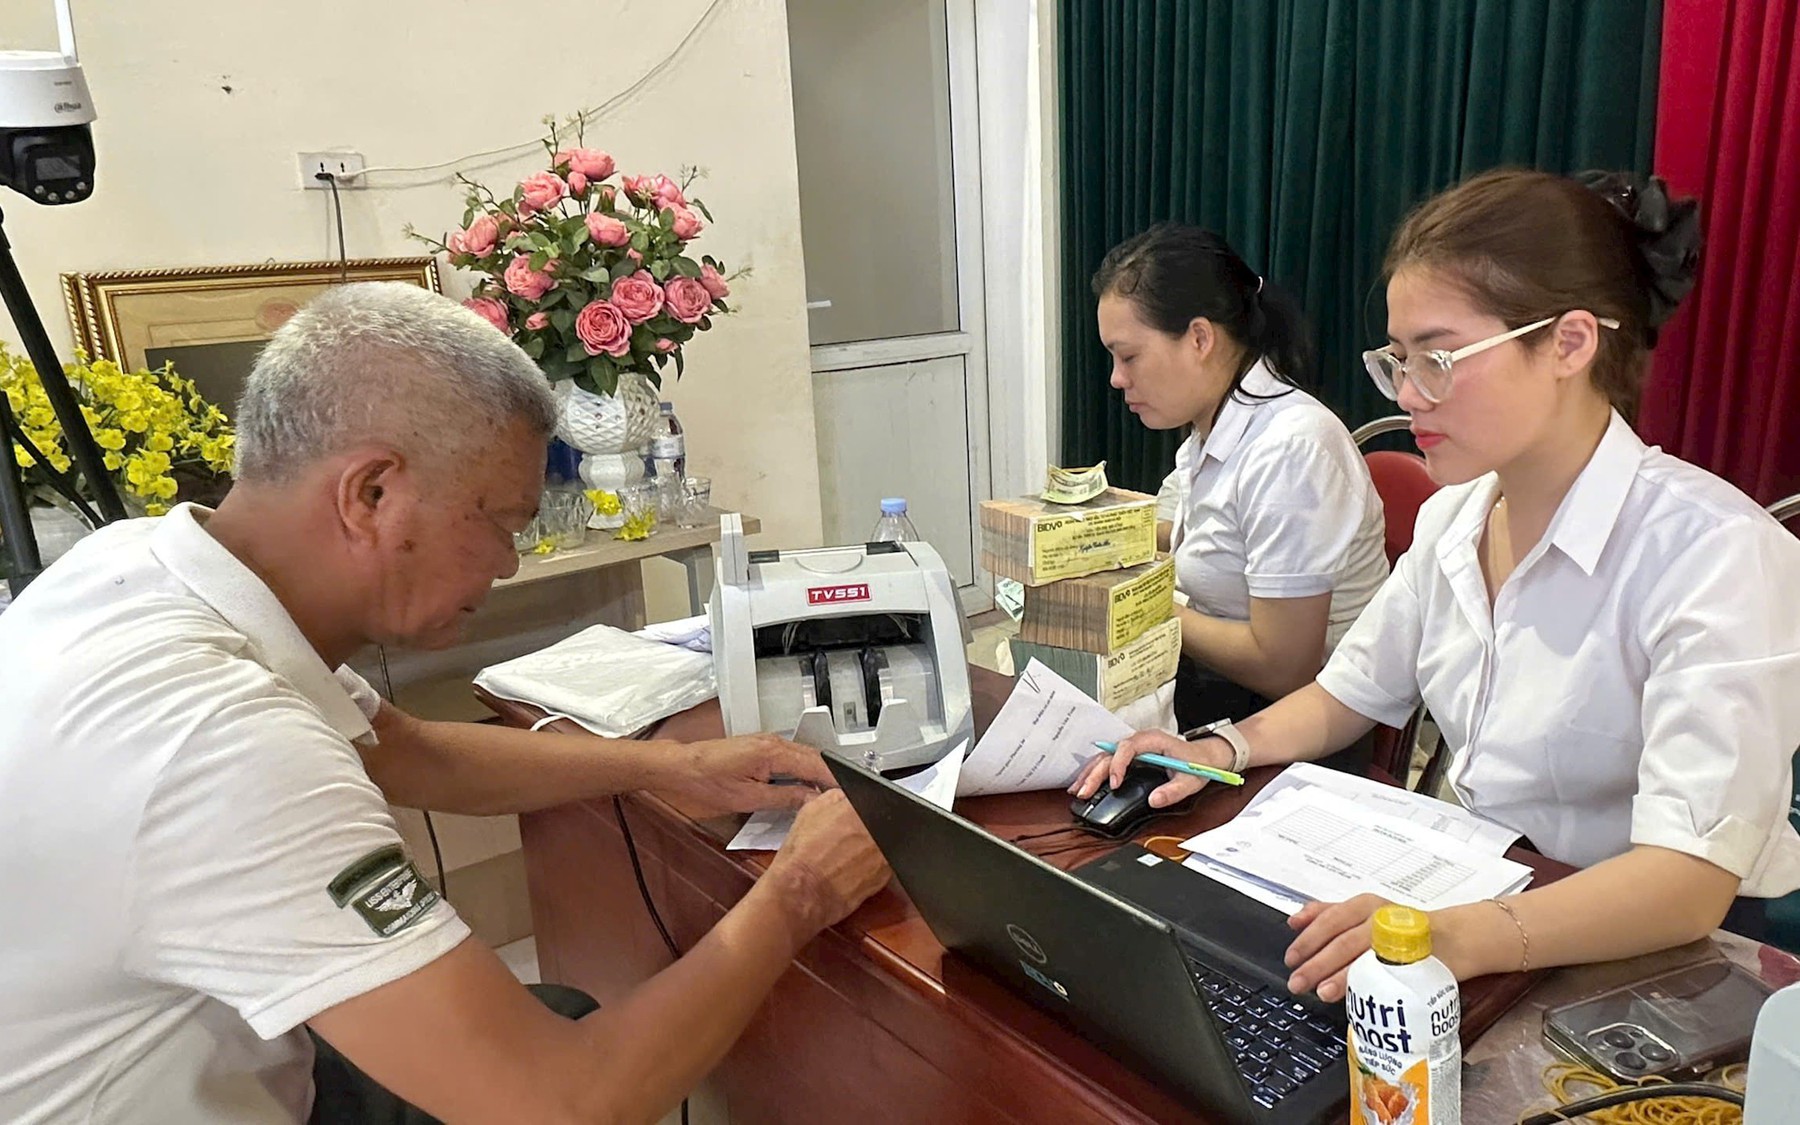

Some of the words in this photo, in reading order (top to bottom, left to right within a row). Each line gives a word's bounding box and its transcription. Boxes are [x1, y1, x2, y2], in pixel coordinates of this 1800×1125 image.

[1037, 522, 1057, 533] BIDV
[1348, 986, 1406, 1027] nutri
[1432, 1012, 1459, 1036] boos
